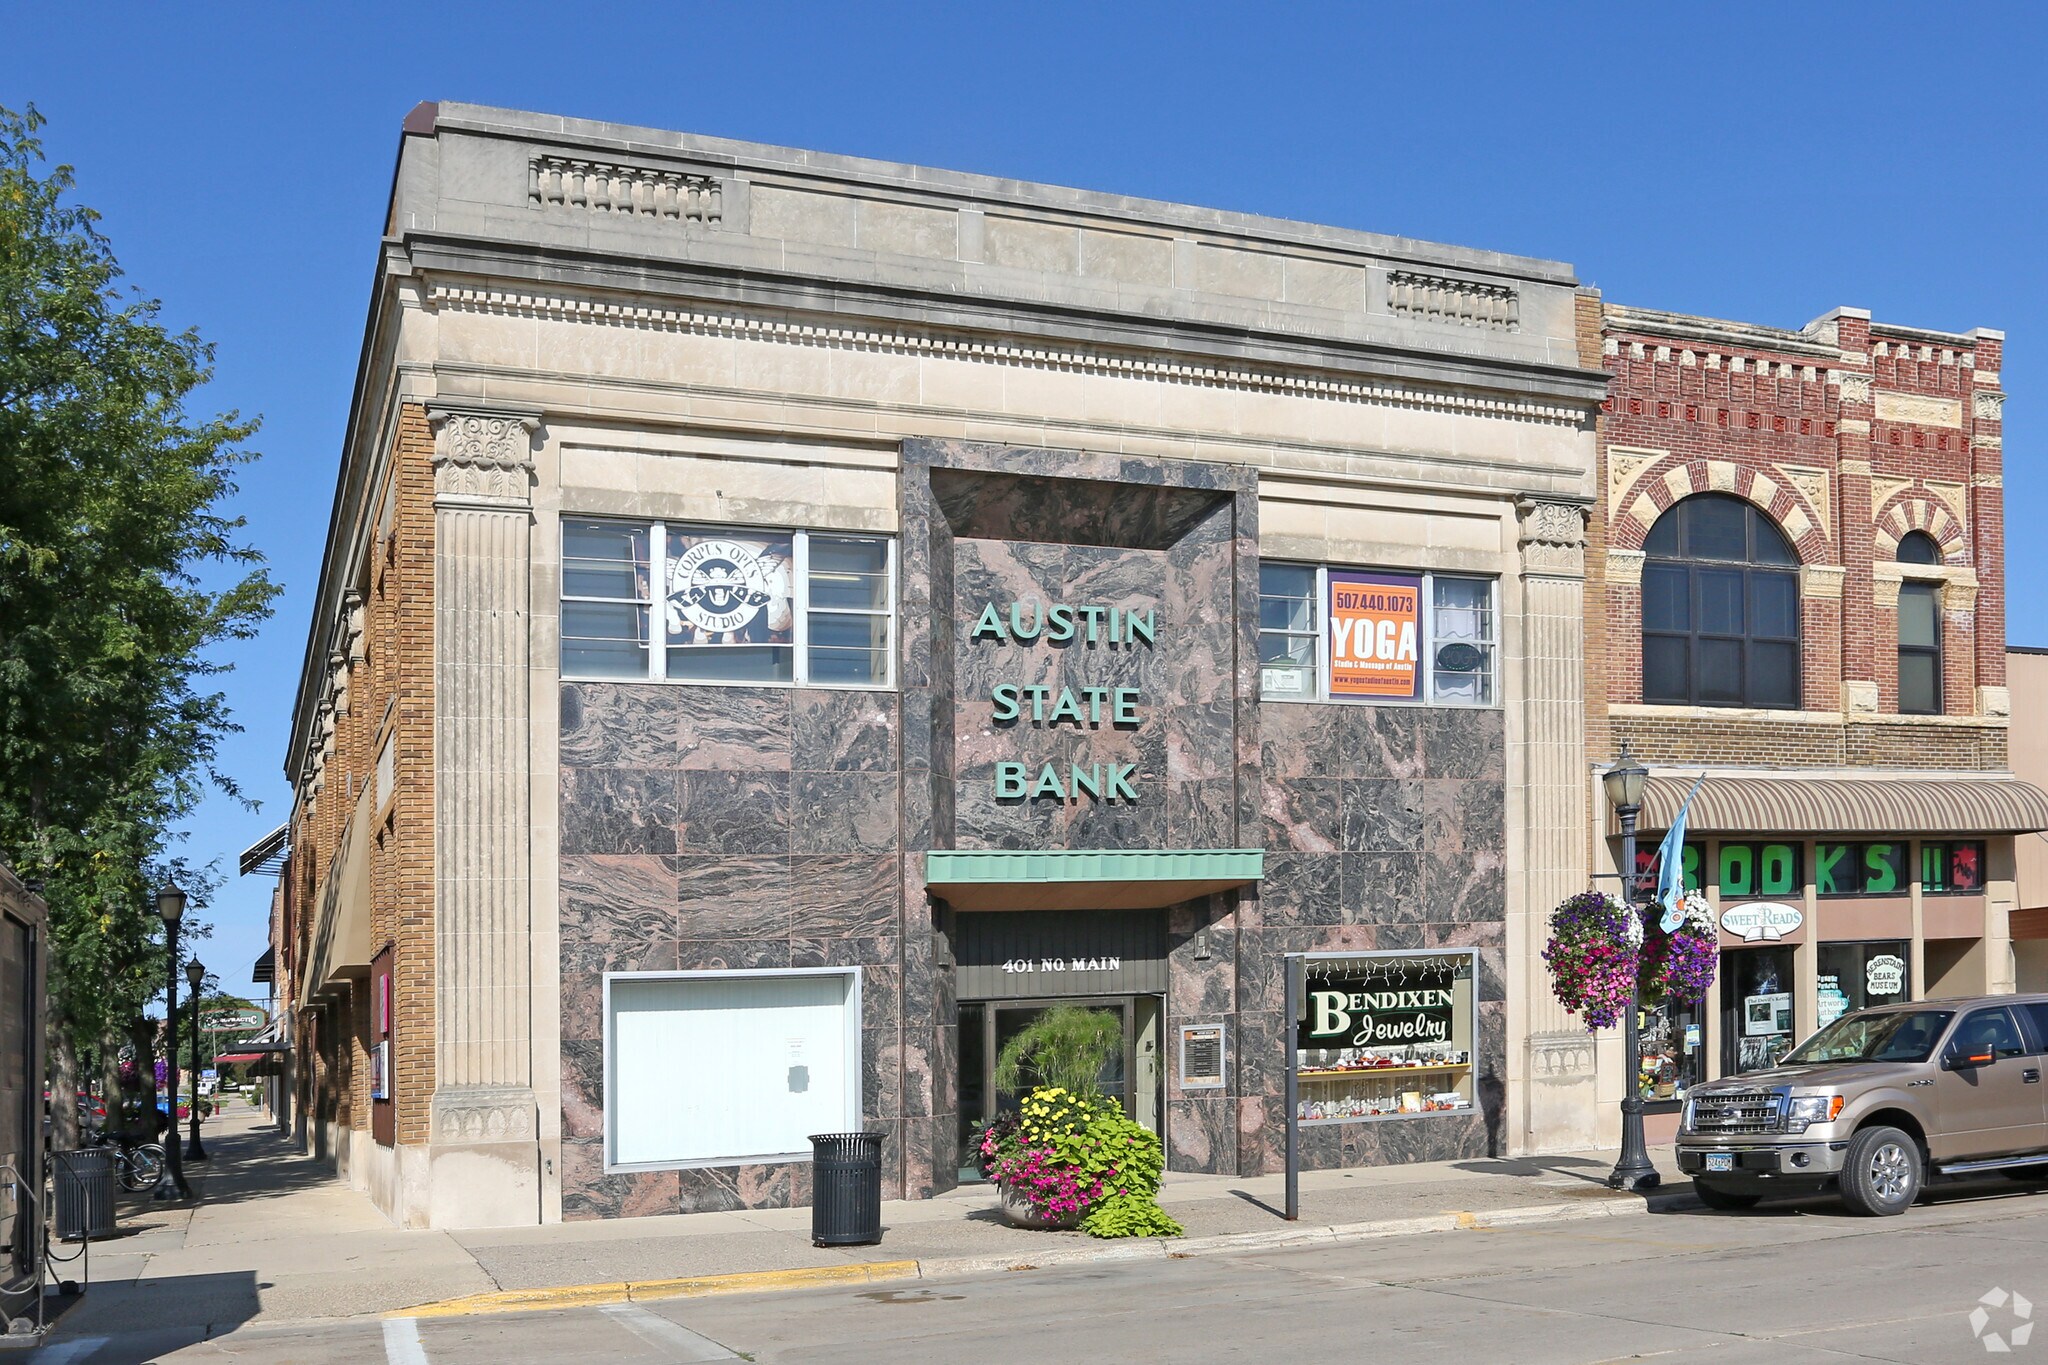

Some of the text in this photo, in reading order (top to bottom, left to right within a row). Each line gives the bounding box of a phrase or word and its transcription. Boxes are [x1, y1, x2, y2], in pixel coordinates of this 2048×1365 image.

[678, 543, 758, 579] CORPUS OPUS
[1336, 592, 1413, 613] 507.440.1073
[697, 612, 744, 629] STUDIO
[971, 601, 1155, 645] AUSTIN
[1330, 616, 1418, 662] YOGA
[1334, 660, 1353, 669] Studio
[1360, 661, 1385, 671] Massage
[1393, 663, 1413, 671] Austin
[992, 683, 1141, 724] STATE
[995, 761, 1138, 800] BANK
[1723, 908, 1801, 927] SWEET READS
[1001, 958, 1034, 974] 401
[1071, 956, 1121, 972] MAIN
[1873, 972, 1896, 981] BEARS
[1870, 981, 1898, 989] MUSEUM
[1311, 988, 1454, 1036] BENDIXEN
[1353, 1013, 1446, 1046] Jewelry
